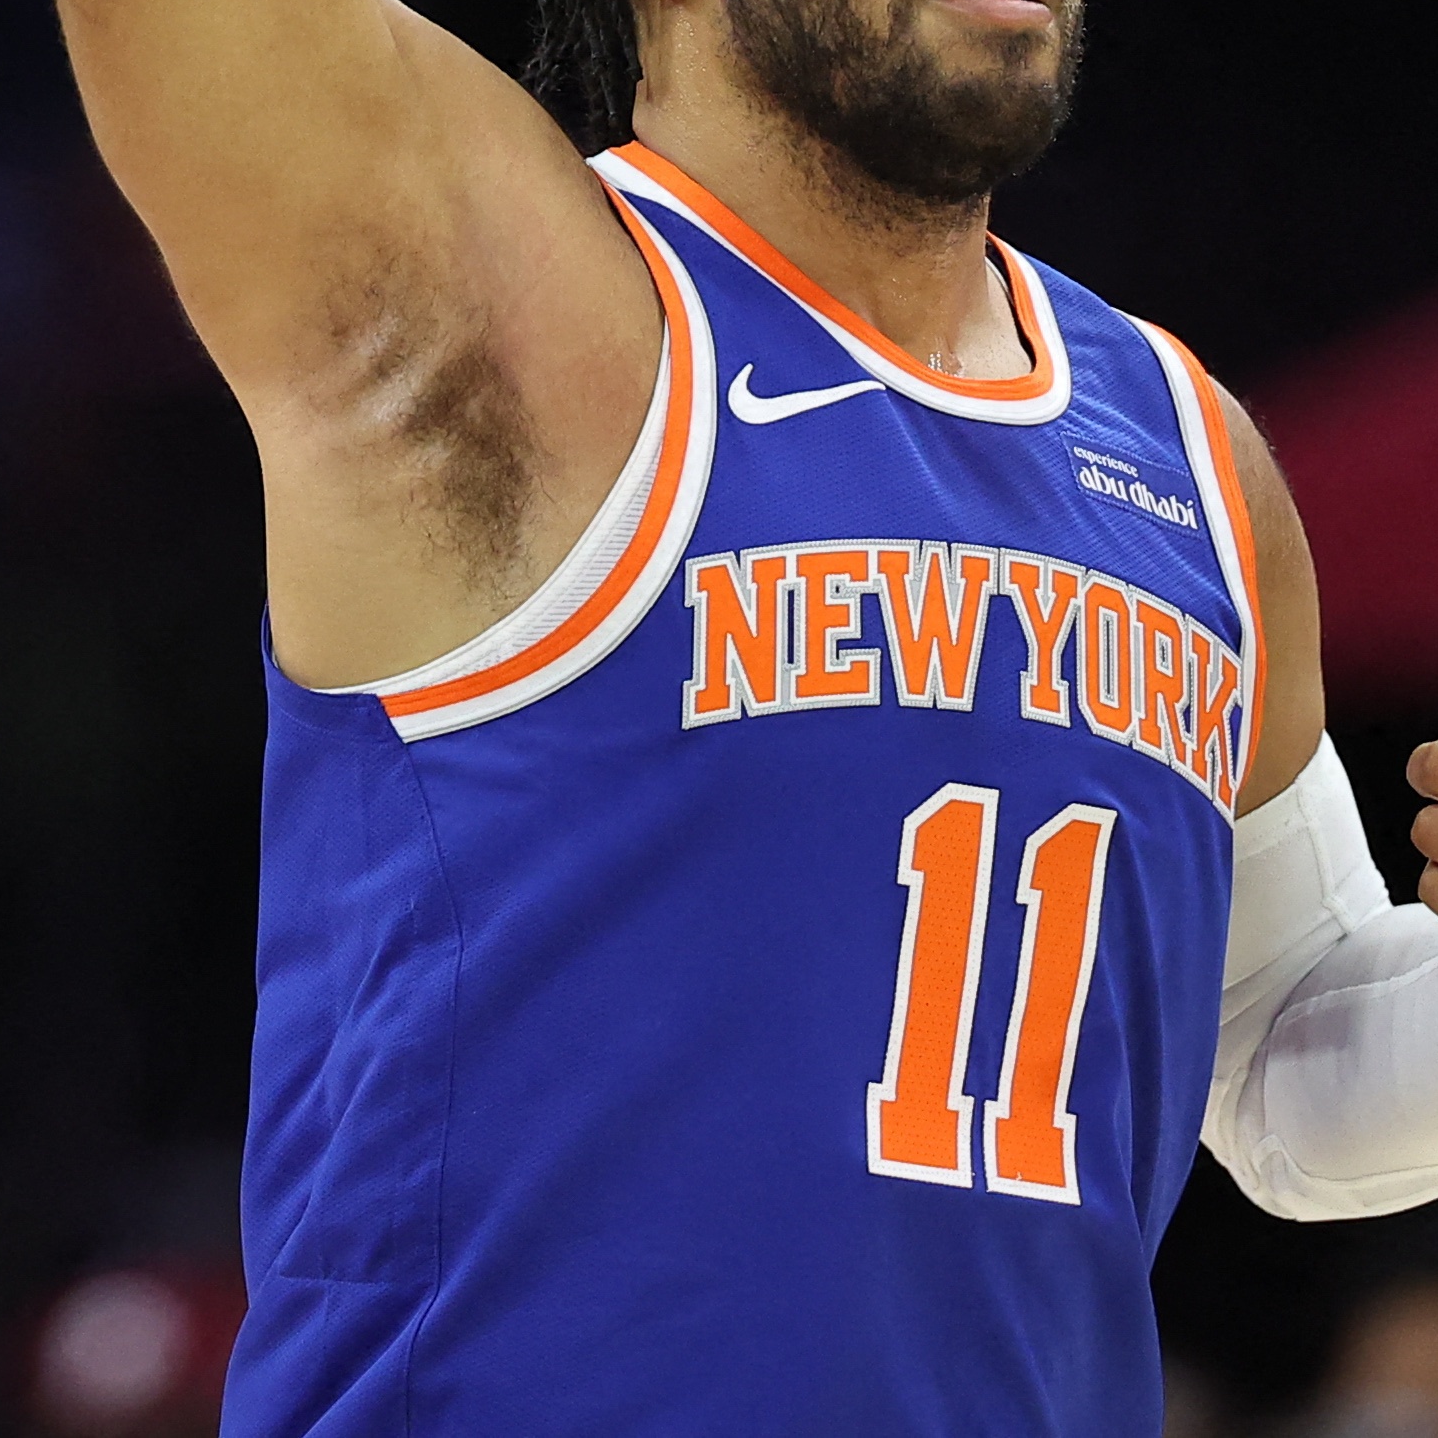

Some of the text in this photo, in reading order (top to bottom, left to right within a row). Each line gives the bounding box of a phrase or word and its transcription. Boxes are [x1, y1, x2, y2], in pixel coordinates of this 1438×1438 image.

[1073, 446, 1139, 478] experience
[1079, 465, 1198, 530] abu dhabi
[682, 539, 1243, 828] NEW YORK
[866, 782, 1118, 1206] 11
